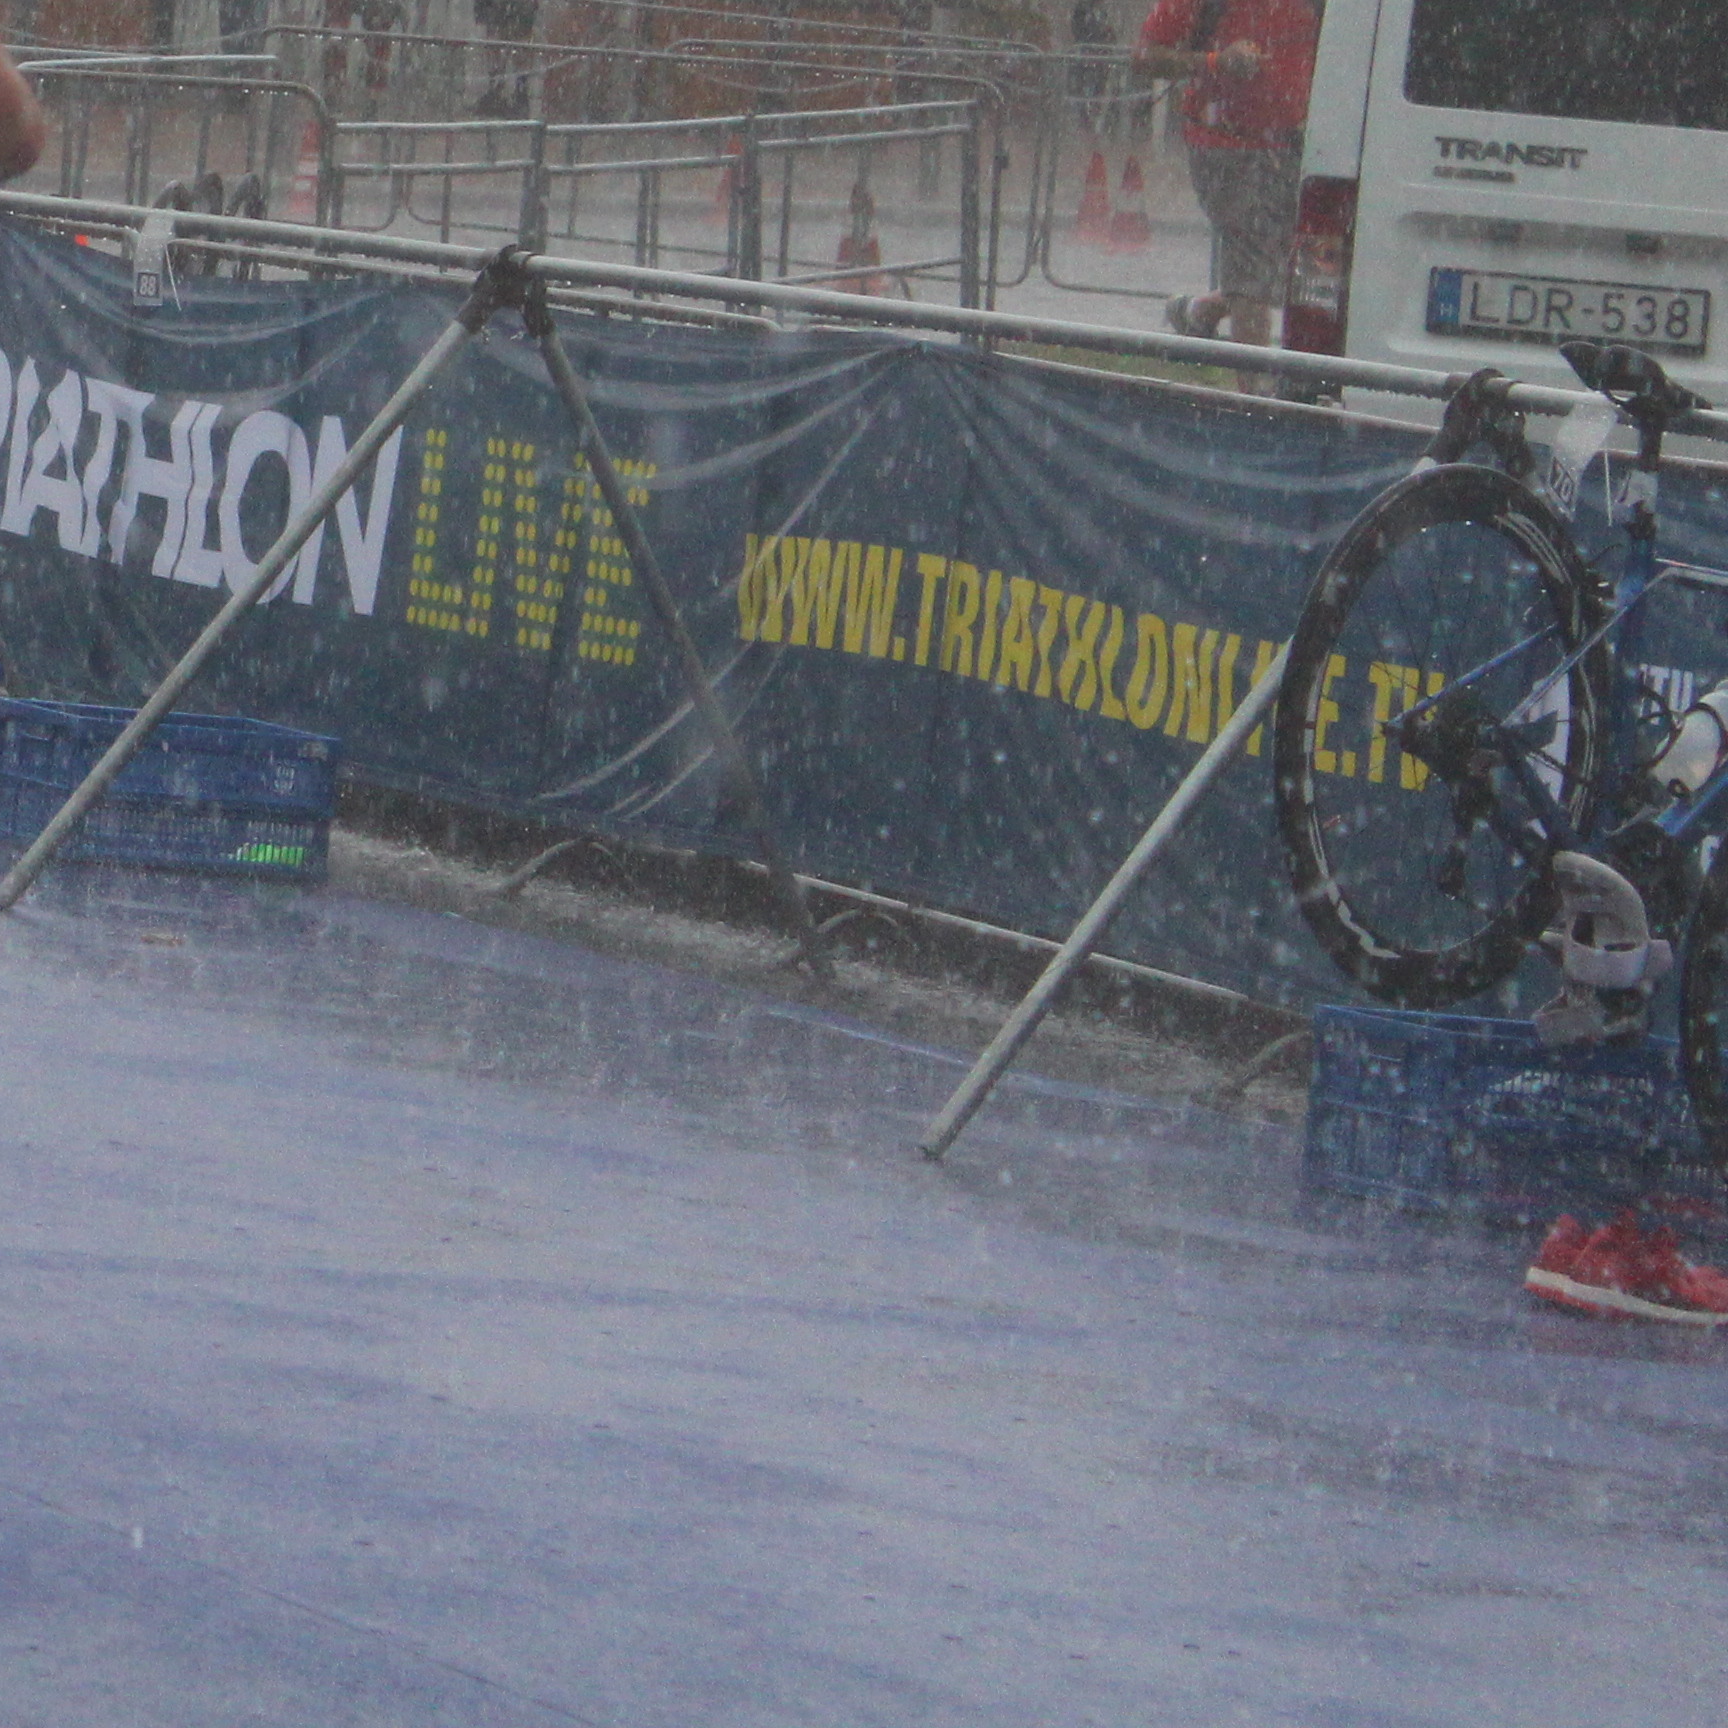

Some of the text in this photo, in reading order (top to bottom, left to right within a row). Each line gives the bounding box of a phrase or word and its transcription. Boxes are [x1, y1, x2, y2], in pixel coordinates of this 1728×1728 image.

[1435, 136, 1588, 170] TRANSIT
[139, 275, 157, 296] 88
[1469, 281, 1690, 340] LDR-538
[406, 428, 657, 667] LIVE
[737, 531, 1446, 791] WWW.TRIATHLONLIE.TV
